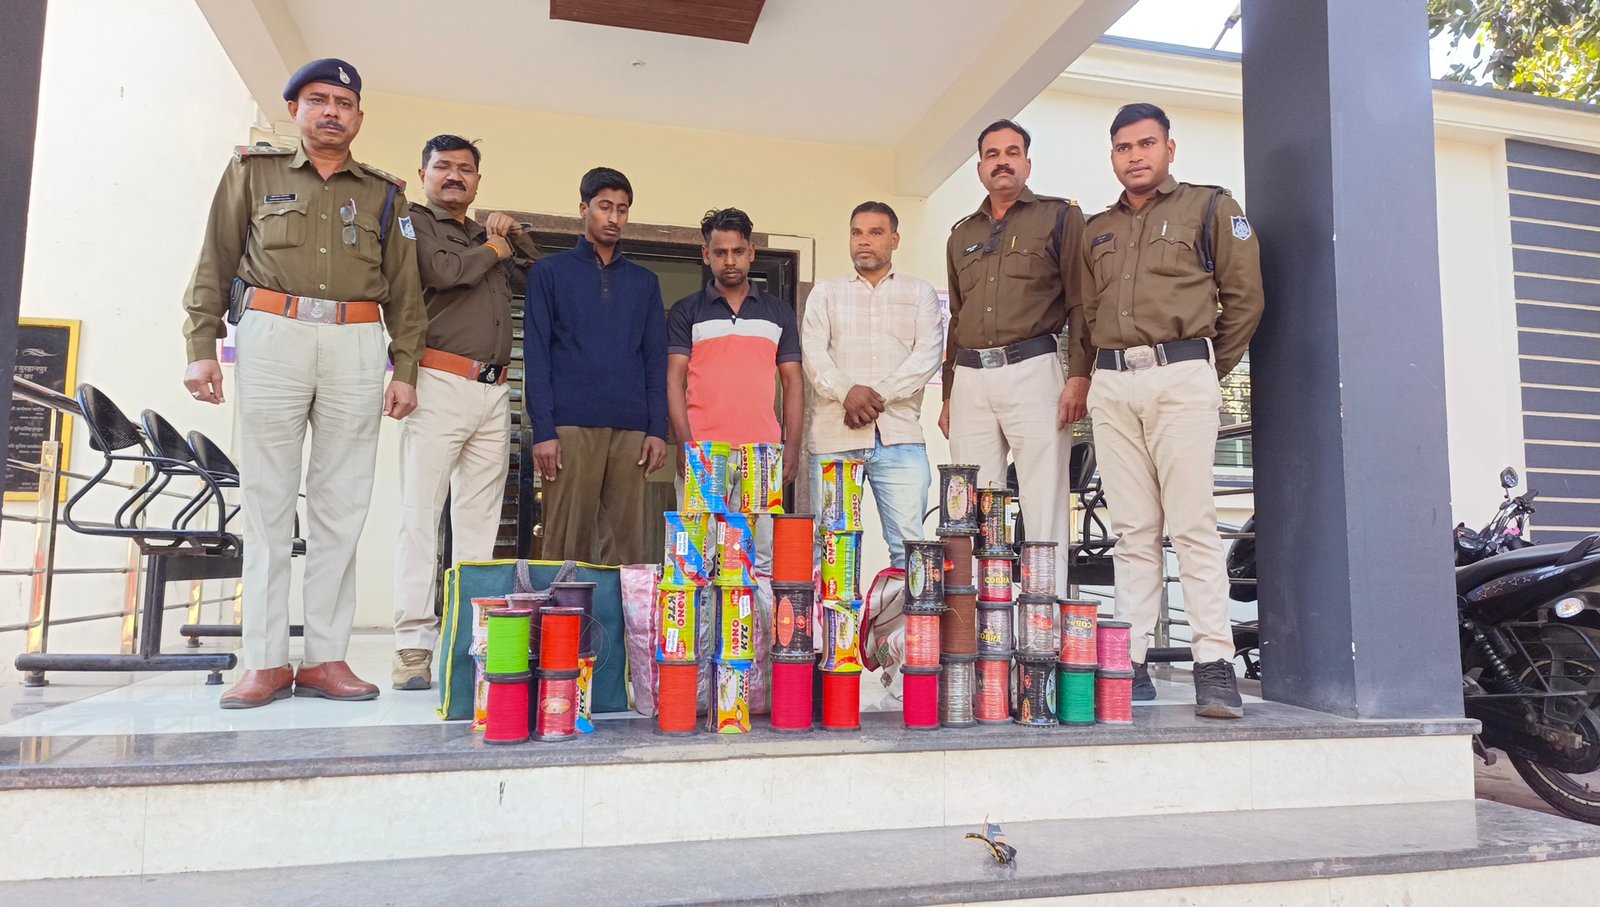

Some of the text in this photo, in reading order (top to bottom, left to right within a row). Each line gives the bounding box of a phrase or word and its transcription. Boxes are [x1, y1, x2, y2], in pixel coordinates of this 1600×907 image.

[741, 446, 749, 479] MONO
[852, 493, 860, 527] MONO
[984, 575, 1011, 584] COBRA
[667, 595, 676, 622] KTC
[677, 591, 685, 627] MONO
[732, 619, 740, 656] MONO
[740, 624, 749, 651] KTC
